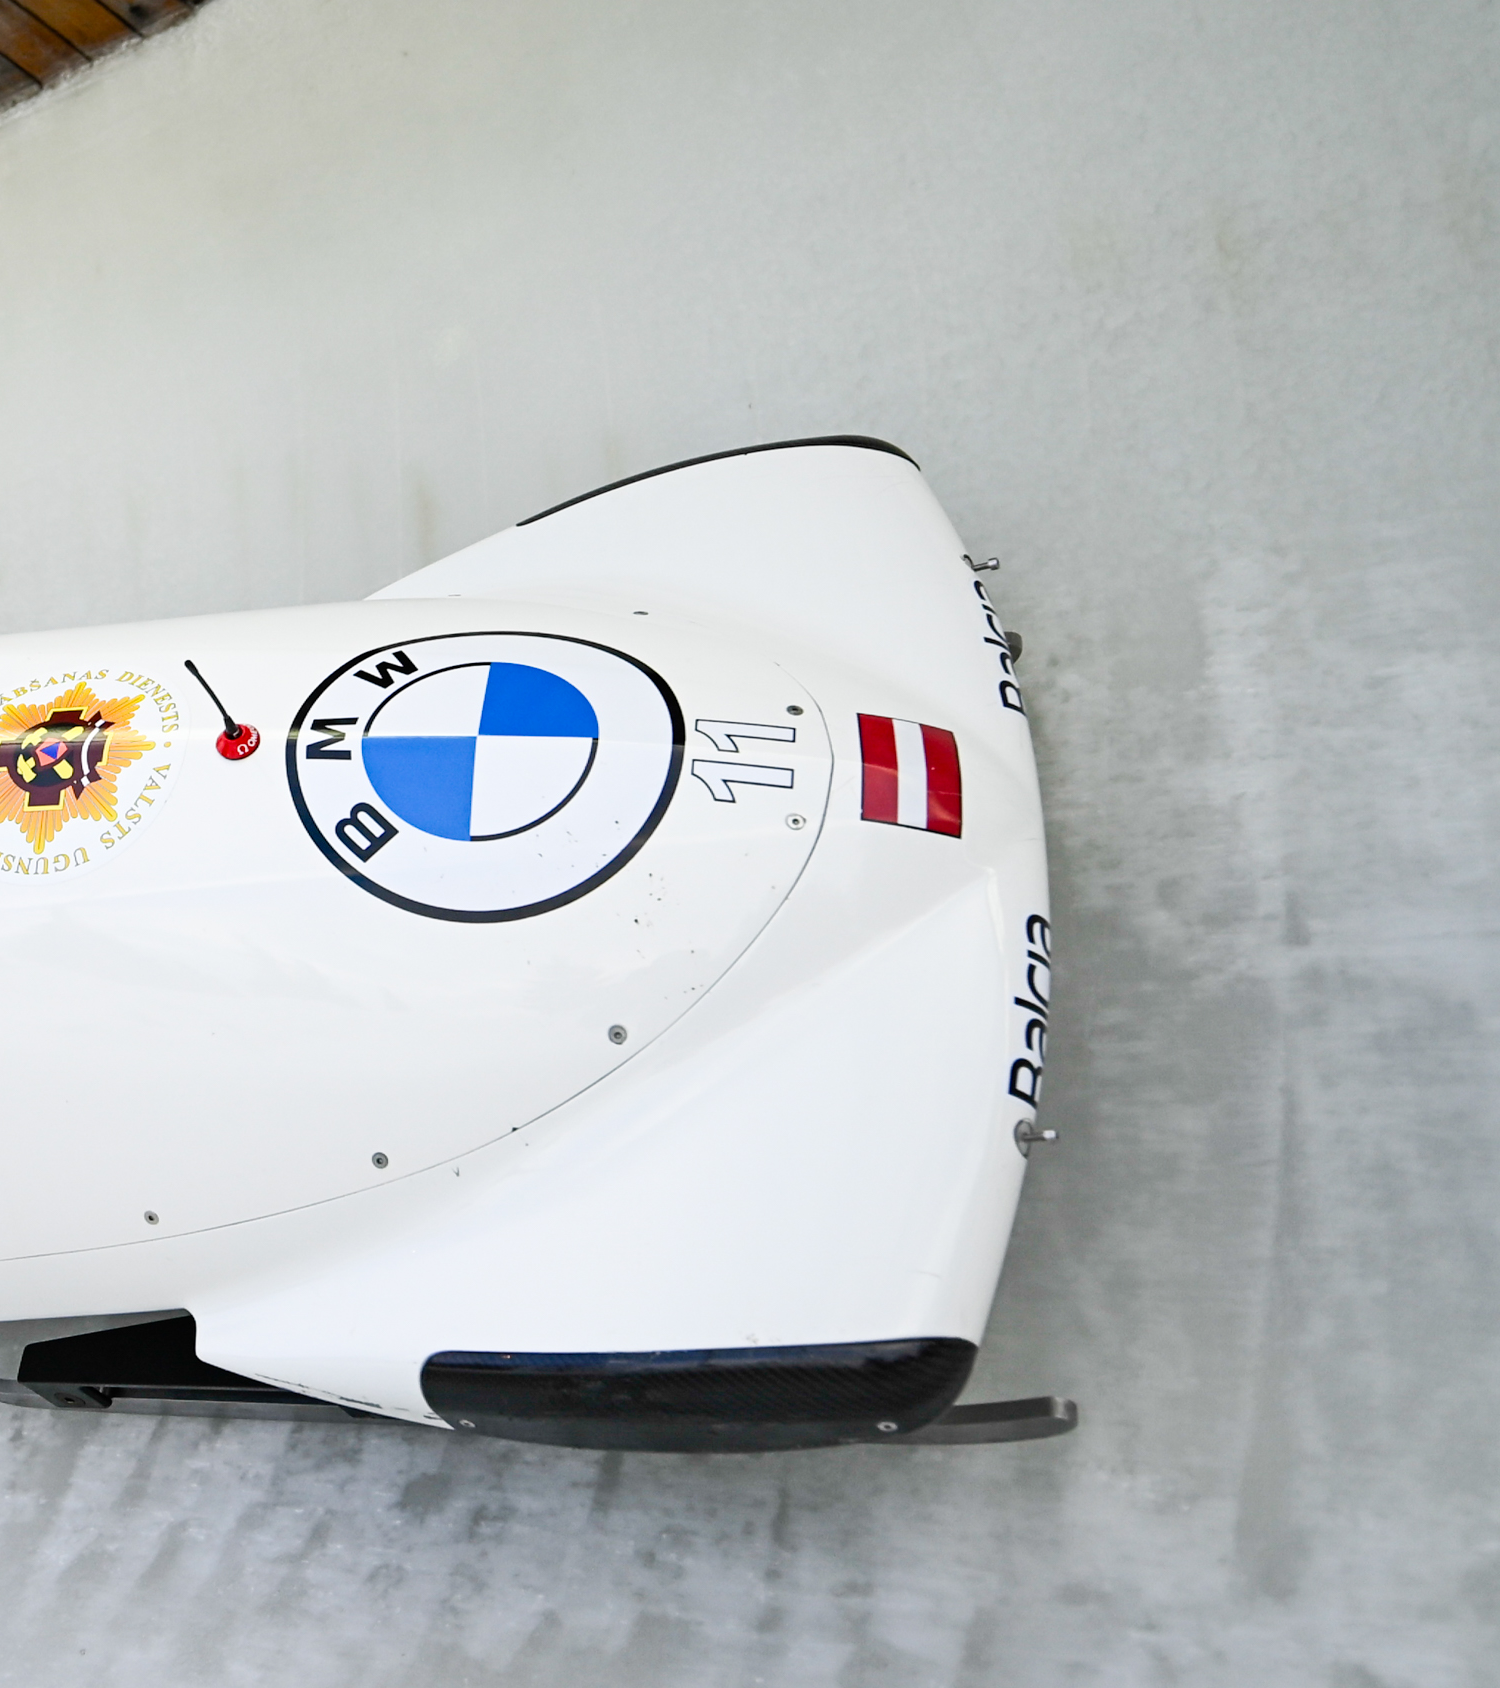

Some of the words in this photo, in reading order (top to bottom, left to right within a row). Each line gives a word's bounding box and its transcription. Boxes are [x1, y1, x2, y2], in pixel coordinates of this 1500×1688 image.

[115, 670, 180, 733] DIENESTS
[306, 650, 419, 863] BMW
[691, 718, 797, 804] 11
[100, 763, 172, 850] VALSTS
